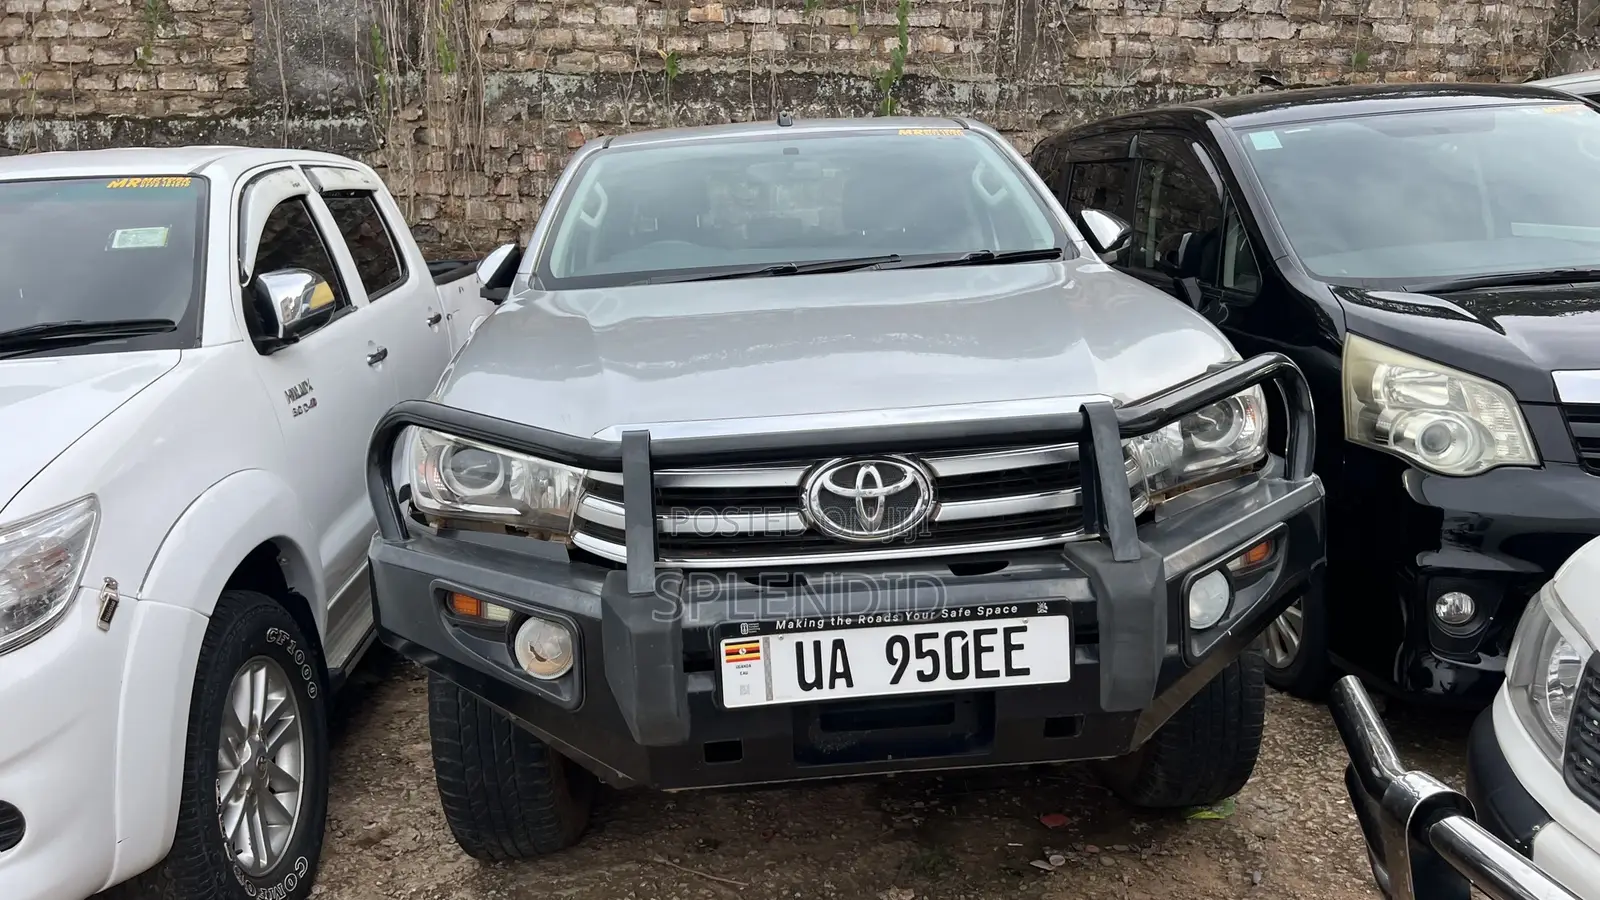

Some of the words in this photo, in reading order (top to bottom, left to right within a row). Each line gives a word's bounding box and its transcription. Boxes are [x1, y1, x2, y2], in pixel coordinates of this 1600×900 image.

[775, 618, 825, 630] Making
[831, 615, 852, 626] the
[858, 612, 899, 624] Roads
[904, 610, 936, 621] Your
[941, 607, 971, 618] Safe
[977, 605, 1018, 617] Space
[266, 627, 318, 699] CF1000
[795, 638, 854, 691] UA
[885, 625, 1031, 685] 950EE
